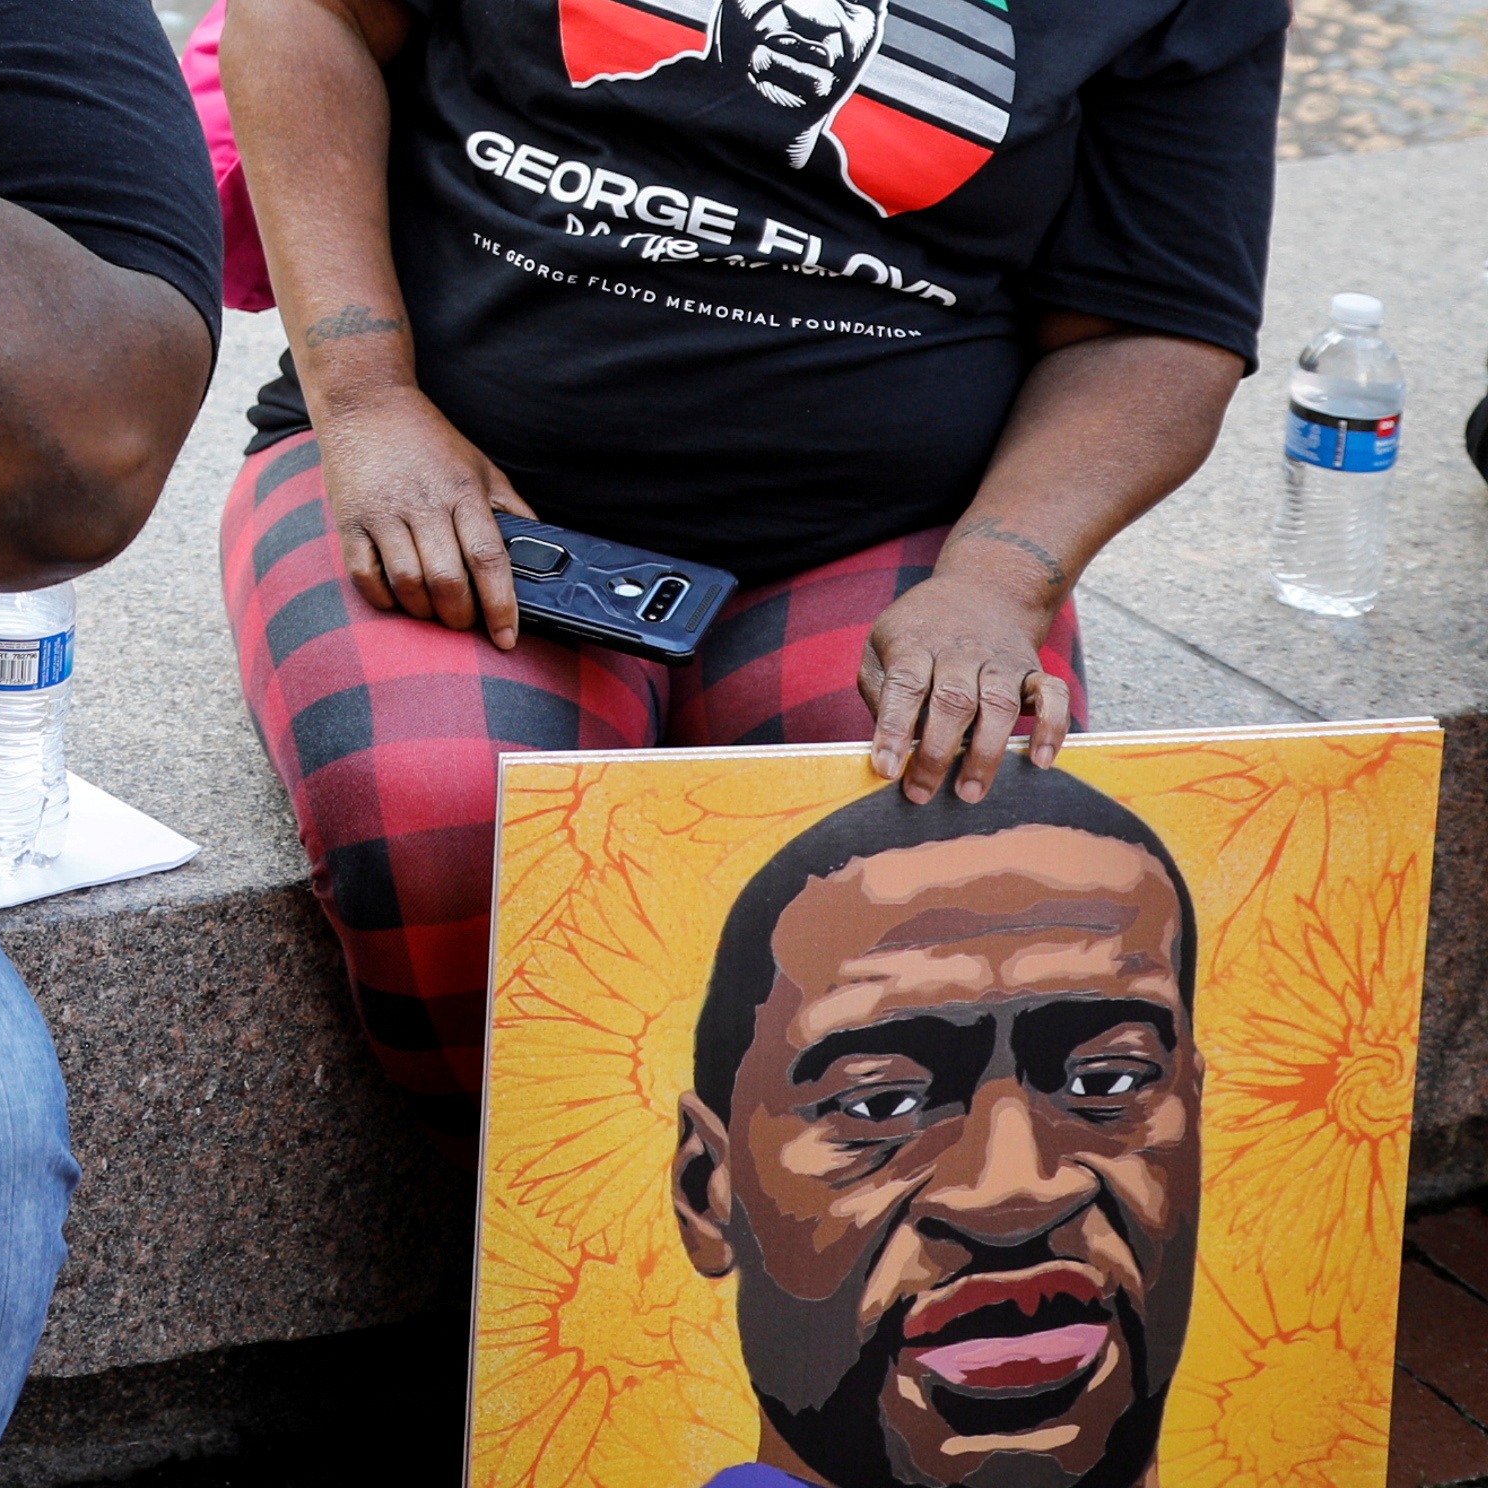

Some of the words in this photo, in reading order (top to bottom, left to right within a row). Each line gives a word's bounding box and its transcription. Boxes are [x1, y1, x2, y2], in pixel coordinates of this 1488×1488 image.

[466, 130, 739, 245] GEORGE
[472, 232, 501, 256] THE
[506, 249, 579, 284] GEORGE
[588, 275, 657, 303] FLOYD
[666, 295, 782, 328] MEMORIAL
[791, 316, 923, 340] FOUNDATION
